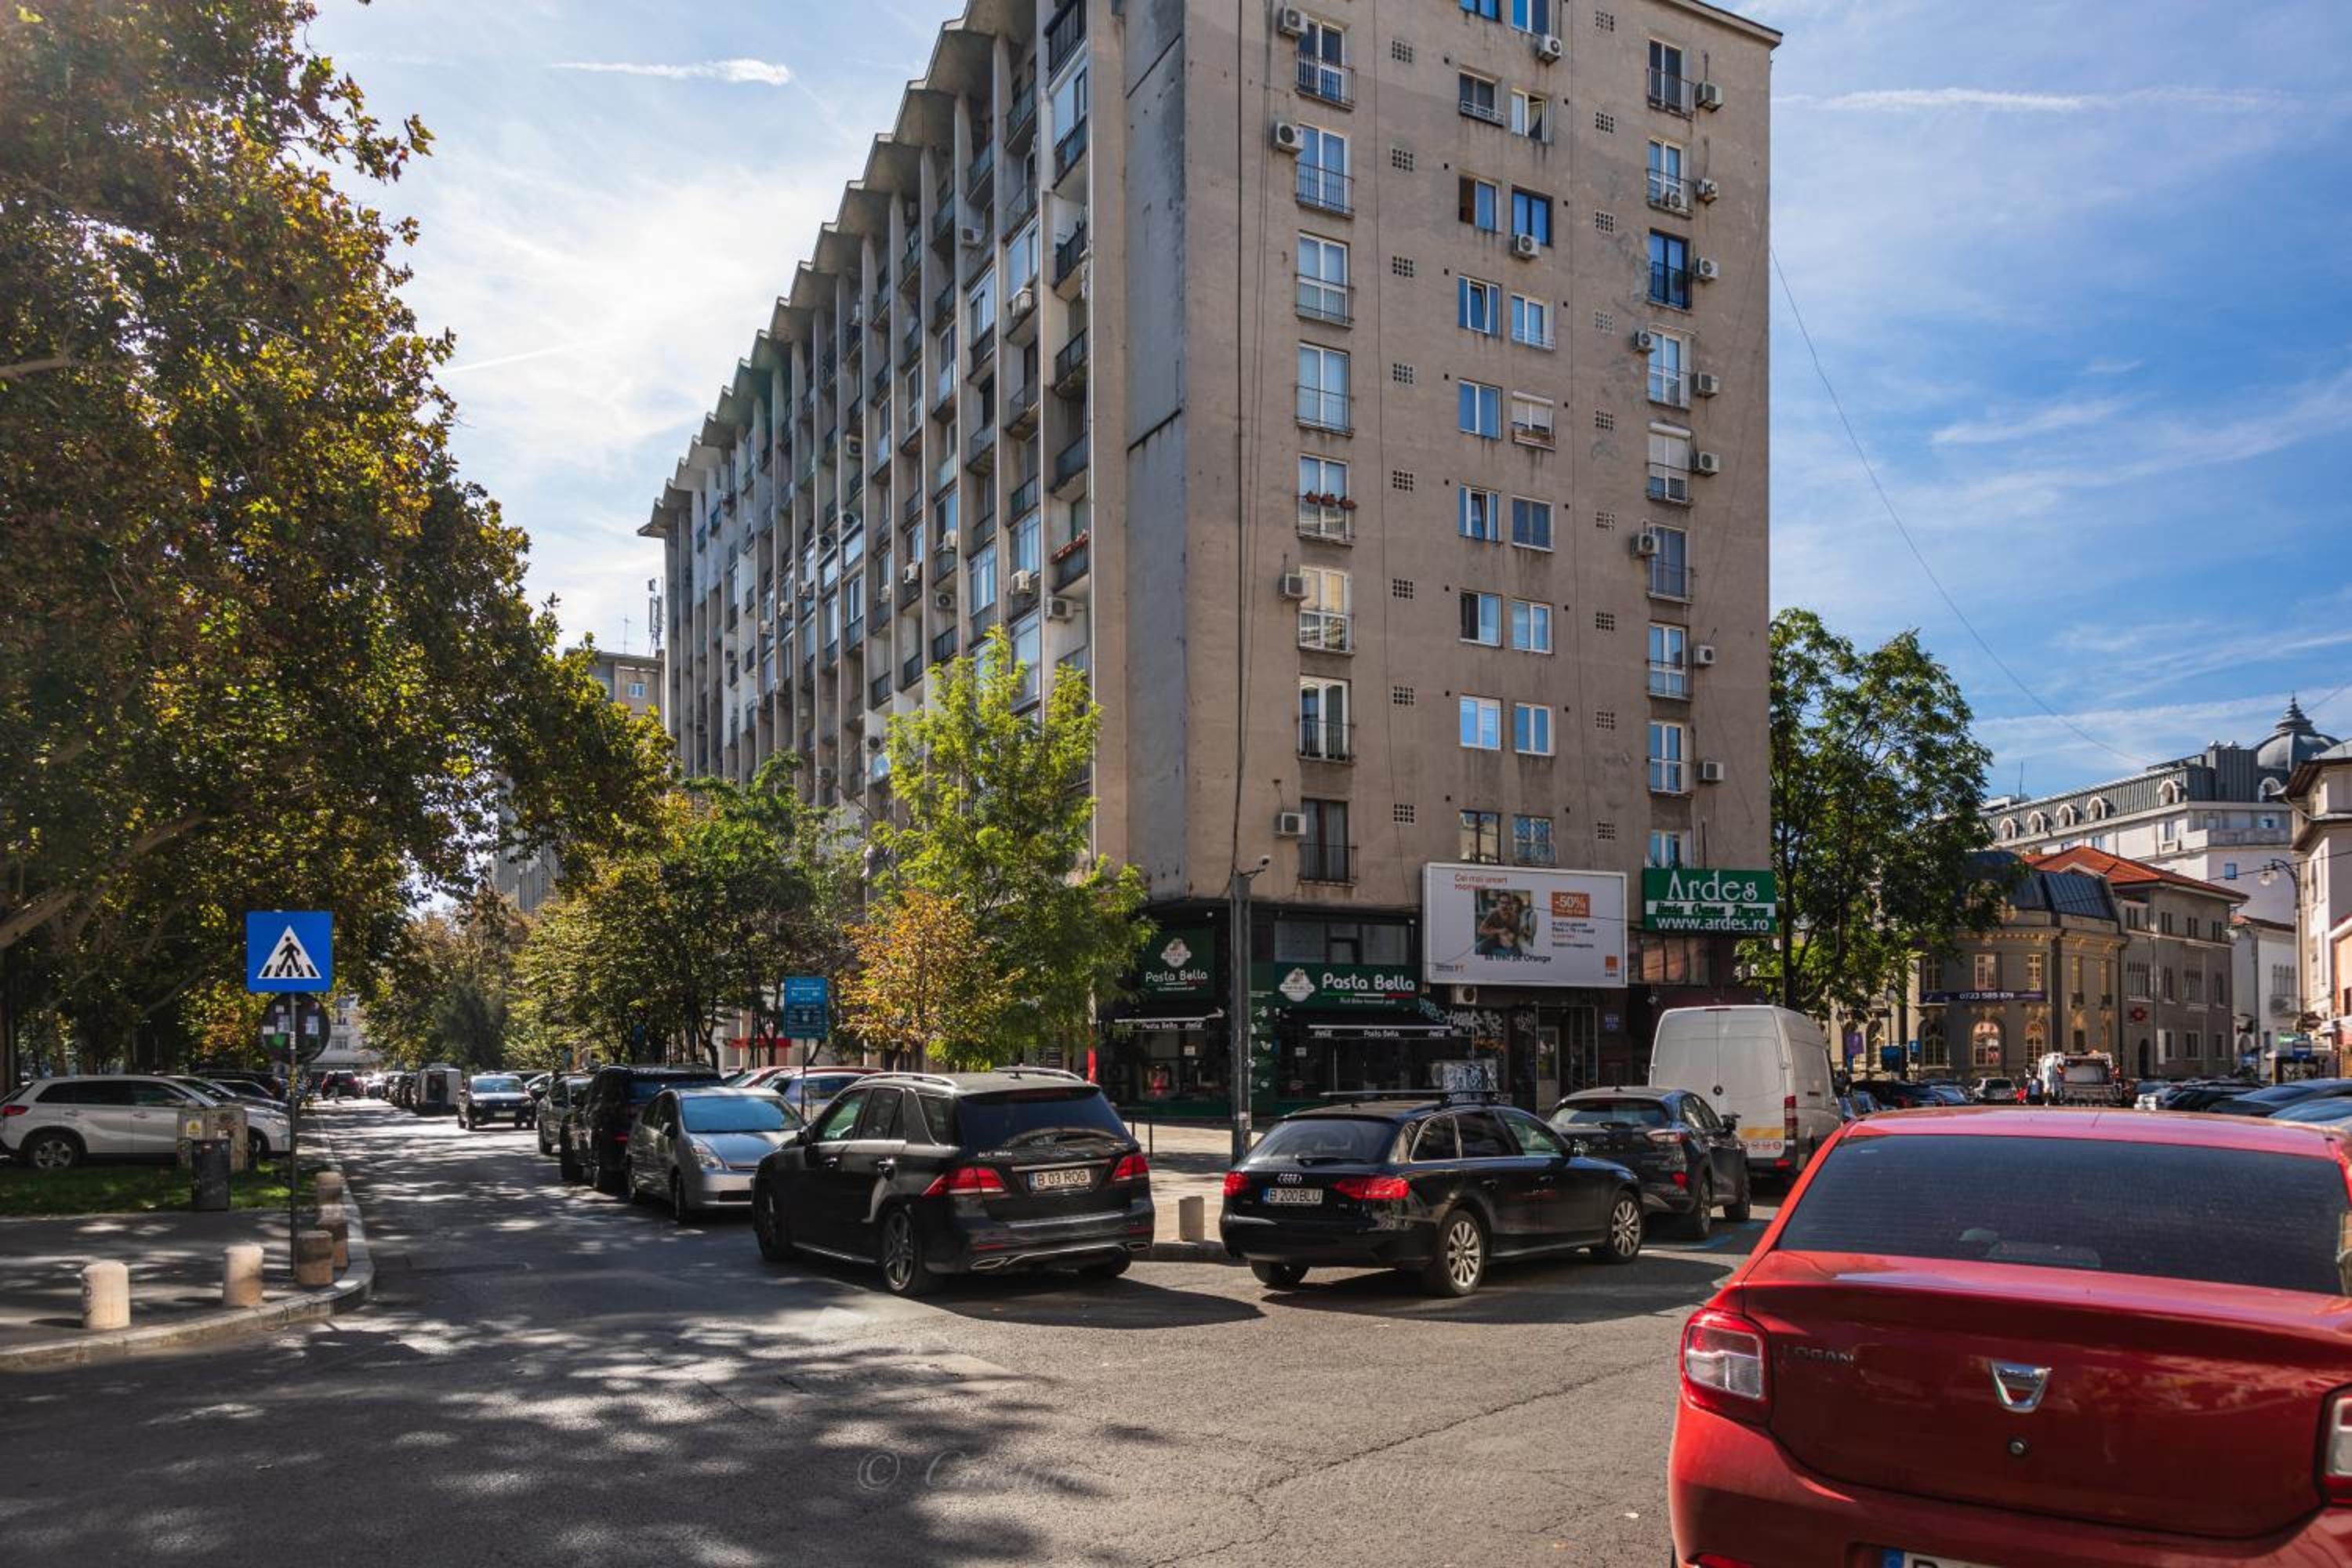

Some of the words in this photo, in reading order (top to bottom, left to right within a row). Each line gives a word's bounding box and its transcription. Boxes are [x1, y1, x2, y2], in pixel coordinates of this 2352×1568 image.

[1666, 869, 1758, 901] Ardes
[1656, 916, 1769, 931] www.ardes.ro
[1145, 971, 1175, 982] Pasta
[1179, 969, 1208, 981] Bella
[1322, 972, 1368, 990] Pasta
[1374, 975, 1416, 991] Bella
[1037, 1174, 1045, 1186] B
[1280, 1189, 1298, 1201] 200
